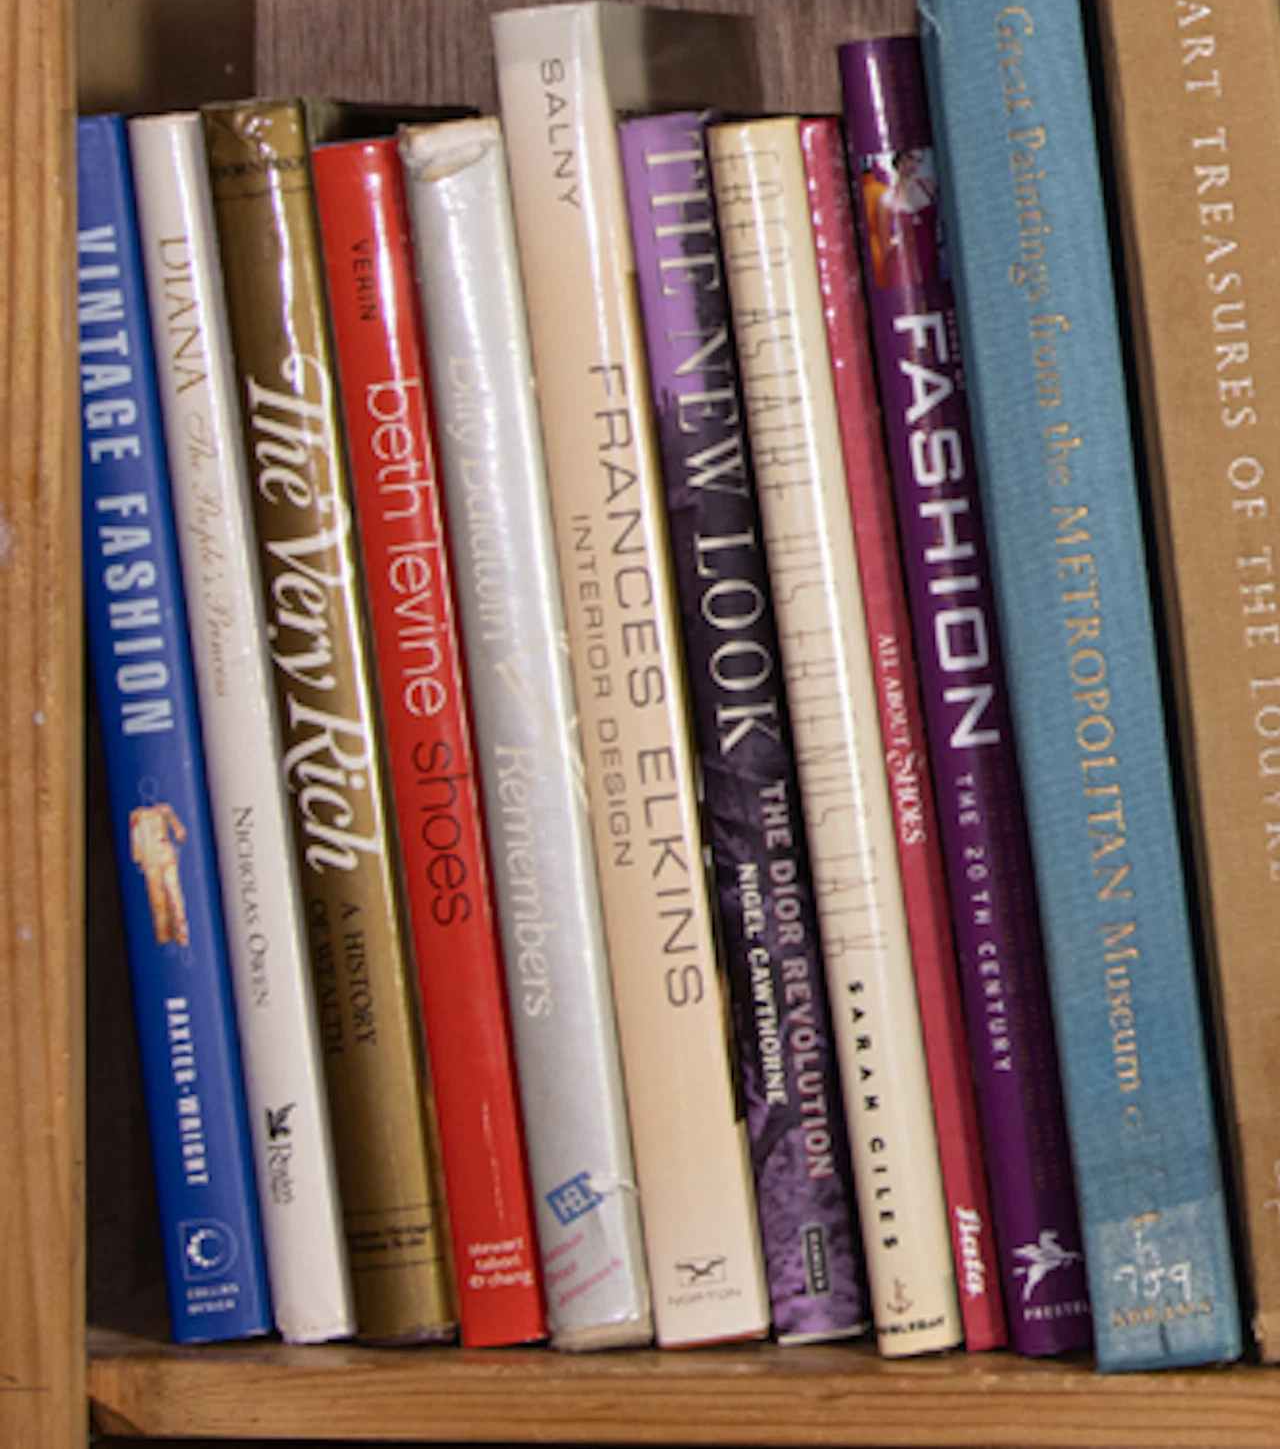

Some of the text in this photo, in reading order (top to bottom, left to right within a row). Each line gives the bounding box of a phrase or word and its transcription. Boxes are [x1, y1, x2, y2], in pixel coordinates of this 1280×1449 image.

[350, 237, 379, 323] VERIN
[540, 58, 581, 210] SALNY
[77, 224, 173, 735] VINTAGE FASHION
[645, 130, 782, 755] THE NEW LOOK
[1193, 127, 1257, 429] TREASURES
[1226, 454, 1268, 521] OF
[366, 377, 473, 926] beth levine shoes
[571, 514, 634, 868] INTERIOR DESIGN
[588, 363, 704, 1008] FRANCES ELKINS
[232, 806, 271, 1008] NICHOLAS OWEN
[737, 862, 789, 1108] NIGEL CAWTHORNE
[759, 780, 835, 1182] THE DIOR REVOLUTION
[847, 981, 898, 1250] SARAH GILES
